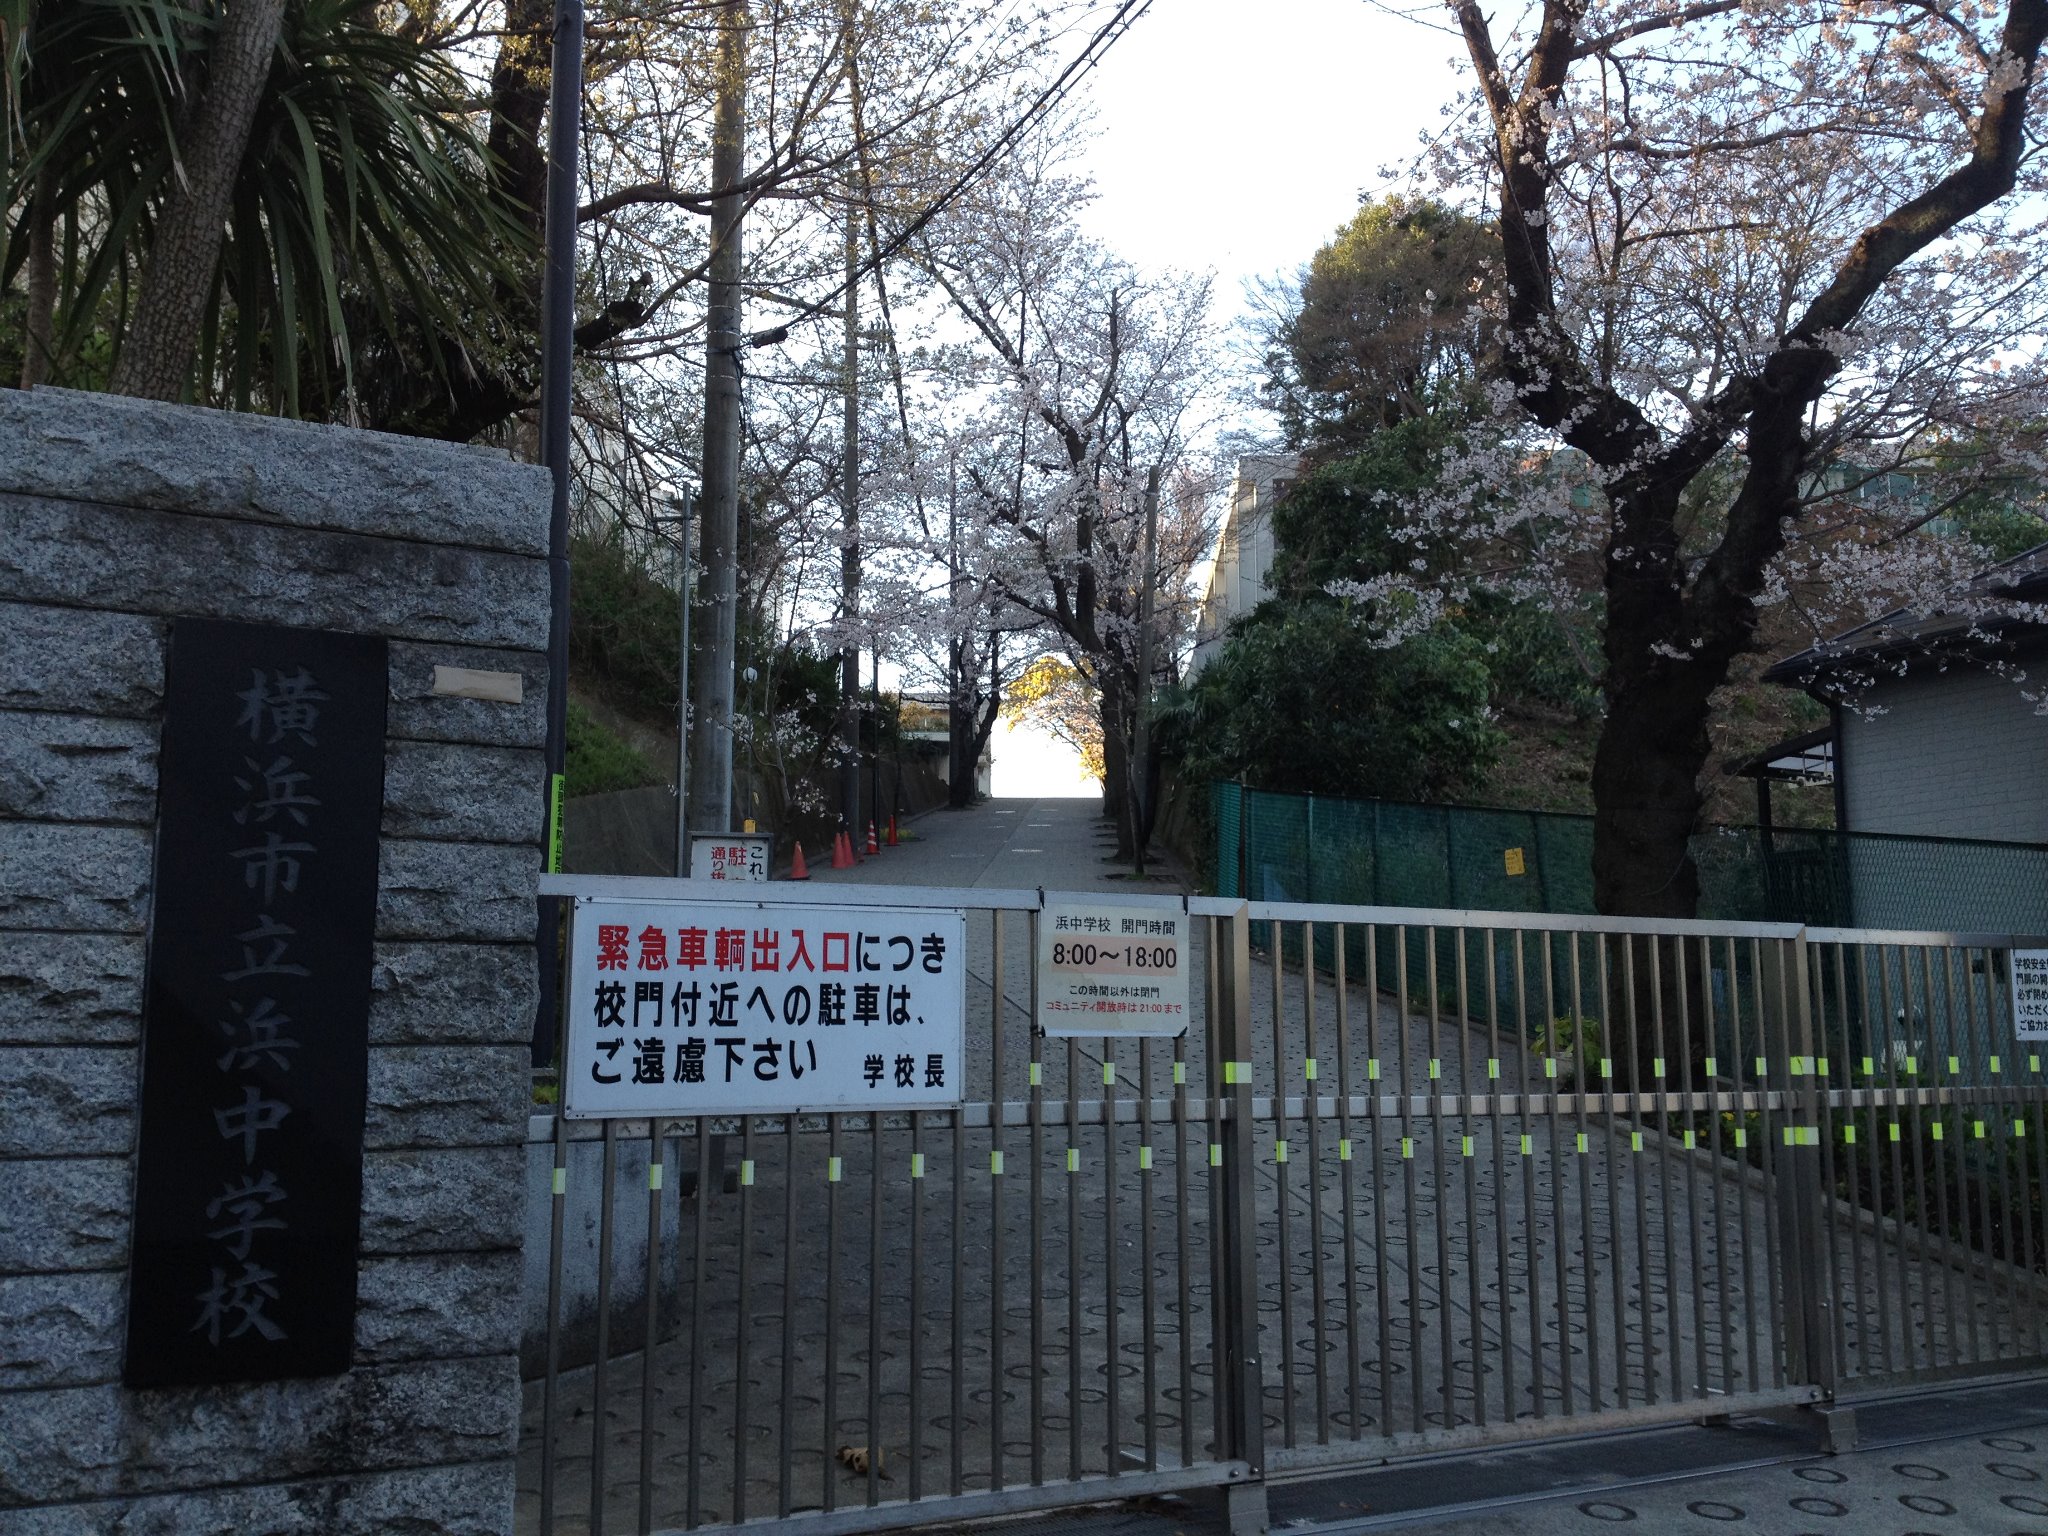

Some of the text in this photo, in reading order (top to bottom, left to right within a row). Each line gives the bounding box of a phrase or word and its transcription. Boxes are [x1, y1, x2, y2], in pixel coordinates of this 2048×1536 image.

[748, 846, 764, 880] これ
[1055, 915, 1176, 936] 浜中学校 開門時間
[2015, 957, 2048, 970] 学校安全
[189, 664, 330, 1346] 横浜市立浜中学校
[593, 980, 924, 1028] 校門付近への駐車は、
[1069, 985, 1160, 999] この時間以外は閉門
[591, 1036, 946, 1088] ご遠慮下さい 学校長
